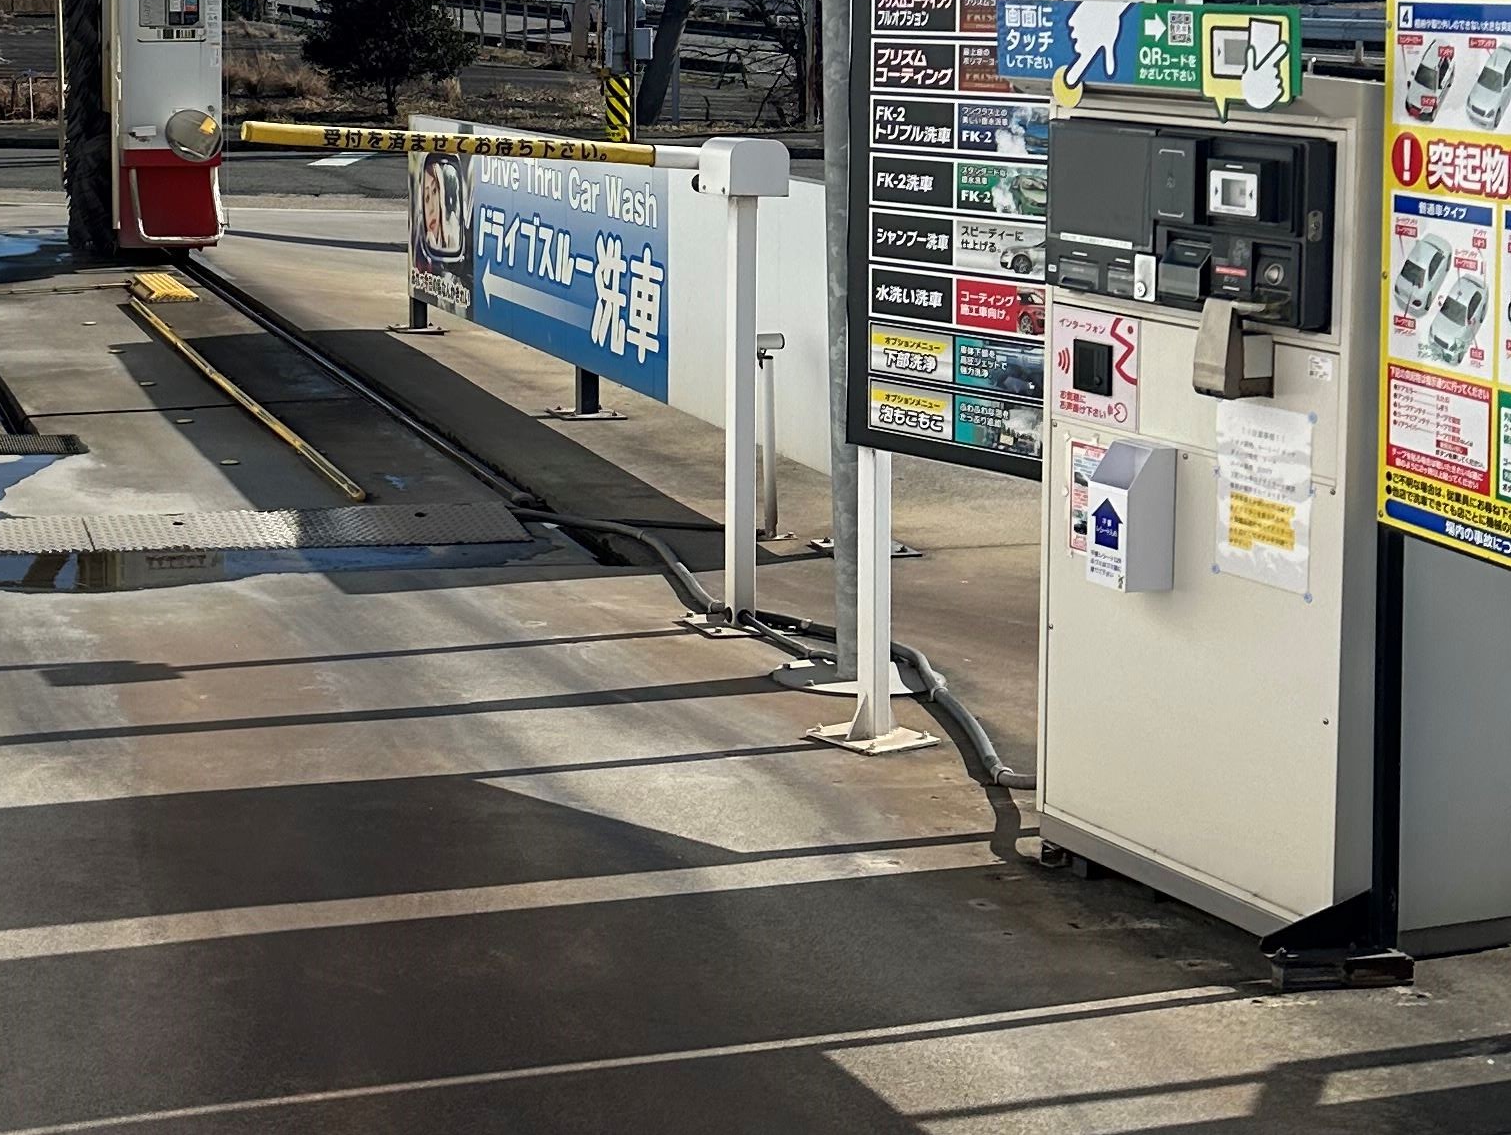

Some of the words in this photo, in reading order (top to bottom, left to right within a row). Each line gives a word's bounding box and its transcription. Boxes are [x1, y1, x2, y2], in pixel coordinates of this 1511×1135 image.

[877, 9, 930, 27] フルオプション
[1005, 4, 1054, 28] 画面に
[1006, 28, 1055, 53] タッチ
[876, 47, 928, 66] プリズム
[1006, 54, 1054, 69] して下さい
[1139, 46, 1197, 69] QRコードを
[875, 67, 953, 86] コーティング
[1138, 67, 1197, 82] かざして下さい
[875, 106, 906, 122] FK-2
[875, 124, 952, 145] トリプル洗車
[961, 130, 992, 143] FK-2
[323, 128, 608, 162] 受付を済ませてお待ち下さい。
[1428, 142, 1510, 196] 突起物
[481, 155, 520, 191] Drive
[524, 158, 562, 201] Thru
[568, 167, 601, 214] Car
[604, 174, 657, 228] Wash
[876, 172, 934, 193] FK-2洗車
[961, 189, 992, 204] FK-2
[1418, 201, 1468, 220] 普通車タイプ
[876, 228, 950, 252] シャンプー洗車
[961, 225, 1024, 242] スピーディーに
[960, 239, 1001, 253] 仕上げる。
[477, 207, 664, 364] ドライブスルー洗車
[875, 286, 943, 309] 水洗い洗車
[960, 290, 1015, 307] コーティング
[1059, 318, 1106, 335] インターフォン
[884, 335, 941, 351] オプションメニュー
[883, 349, 938, 374] 下部洗浄
[884, 392, 941, 409] オプションメニュー
[879, 405, 945, 432] 泡もこもこ
